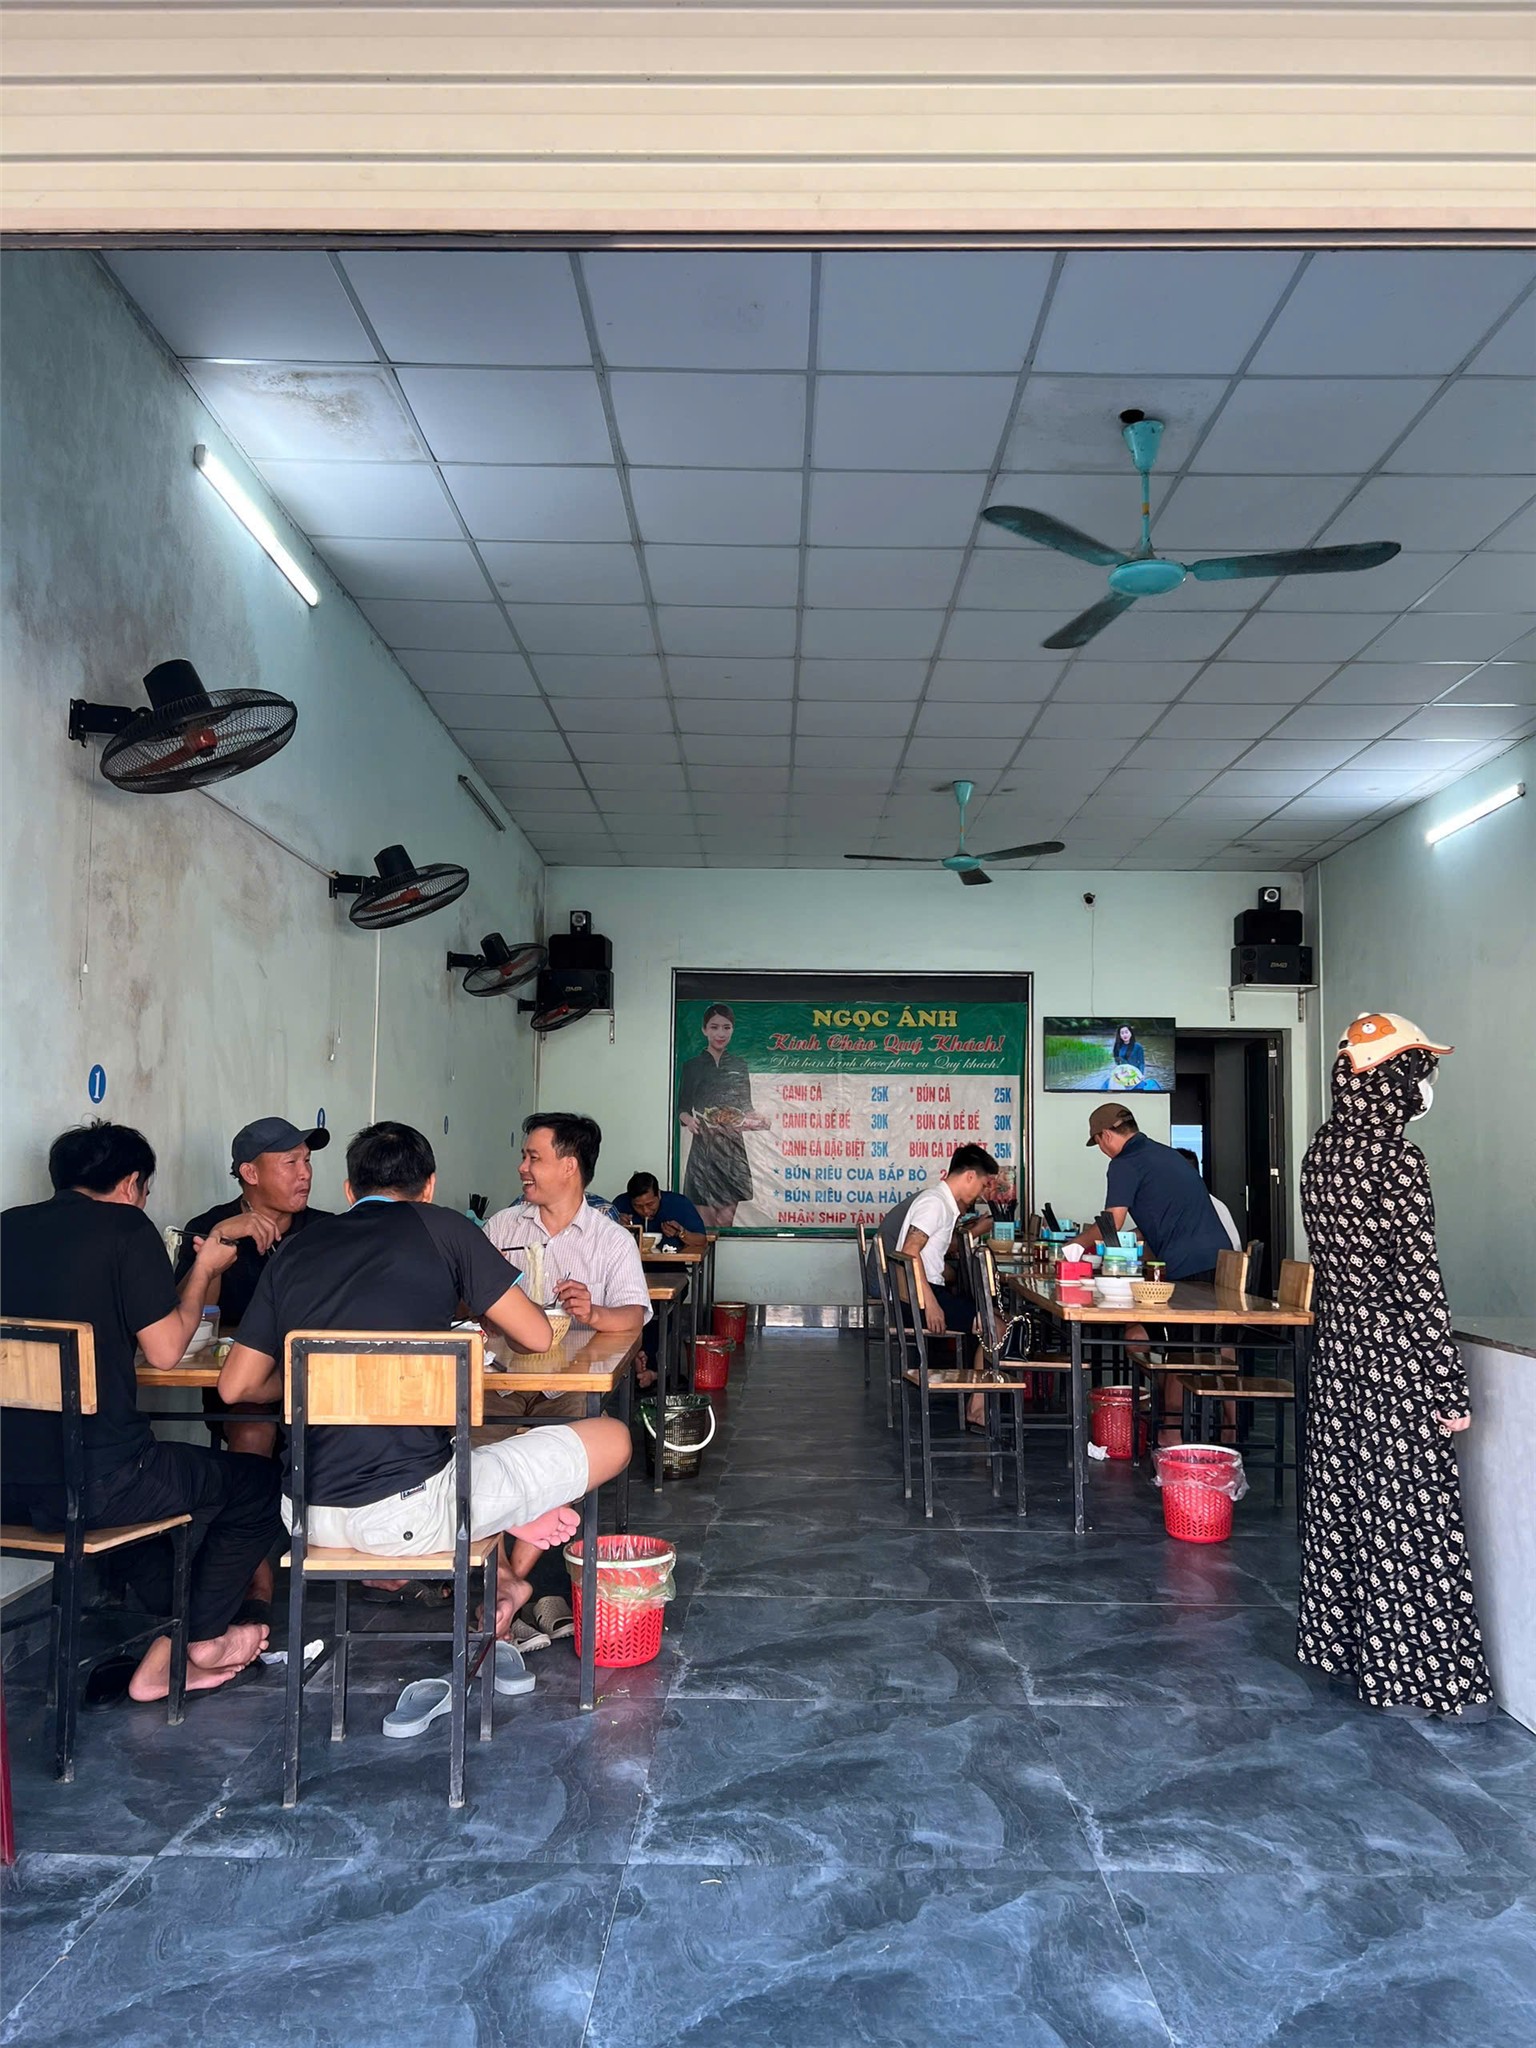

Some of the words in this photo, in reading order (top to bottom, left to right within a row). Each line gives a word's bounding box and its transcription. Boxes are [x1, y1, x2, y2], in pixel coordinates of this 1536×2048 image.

[812, 1009, 890, 1032] NGỌC
[897, 1006, 958, 1028] ÁNH
[827, 1034, 878, 1052] Chào
[884, 1033, 924, 1055] Quý
[928, 1034, 1006, 1052] Khách!
[932, 1055, 963, 1073] Quý
[962, 1056, 1005, 1069] khách!
[94, 1071, 101, 1100] 1
[782, 1085, 808, 1102] CANH
[809, 1082, 823, 1102] CÁ
[871, 1085, 889, 1102] 25K
[916, 1083, 936, 1102] BÚN
[938, 1083, 951, 1102] CÁ
[994, 1087, 1012, 1103] 25K
[782, 1112, 807, 1129] CANH
[809, 1109, 823, 1129] CÁ
[871, 1113, 889, 1130] 30K
[916, 1111, 936, 1130] BÚN
[938, 1111, 951, 1130] CÁ
[994, 1114, 1012, 1131] 30K
[781, 1140, 807, 1157] CANH
[809, 1137, 822, 1157] CÁ
[845, 1138, 866, 1160] BIỆT
[871, 1141, 889, 1158] 35K
[909, 1138, 928, 1158] BÚN
[931, 1138, 944, 1158] CÁ
[784, 1165, 811, 1180] BÚN
[815, 1164, 843, 1181] RIÊU
[847, 1168, 875, 1181] CUA
[879, 1163, 904, 1181] BẮP
[908, 1166, 927, 1181] BÒ
[784, 1187, 811, 1203] BÚN
[815, 1187, 843, 1203] RIÊU
[846, 1190, 875, 1203] CUA
[879, 1186, 902, 1204] HẢI
[778, 1208, 815, 1226] NHẬN
[850, 1208, 875, 1225] TẬN
